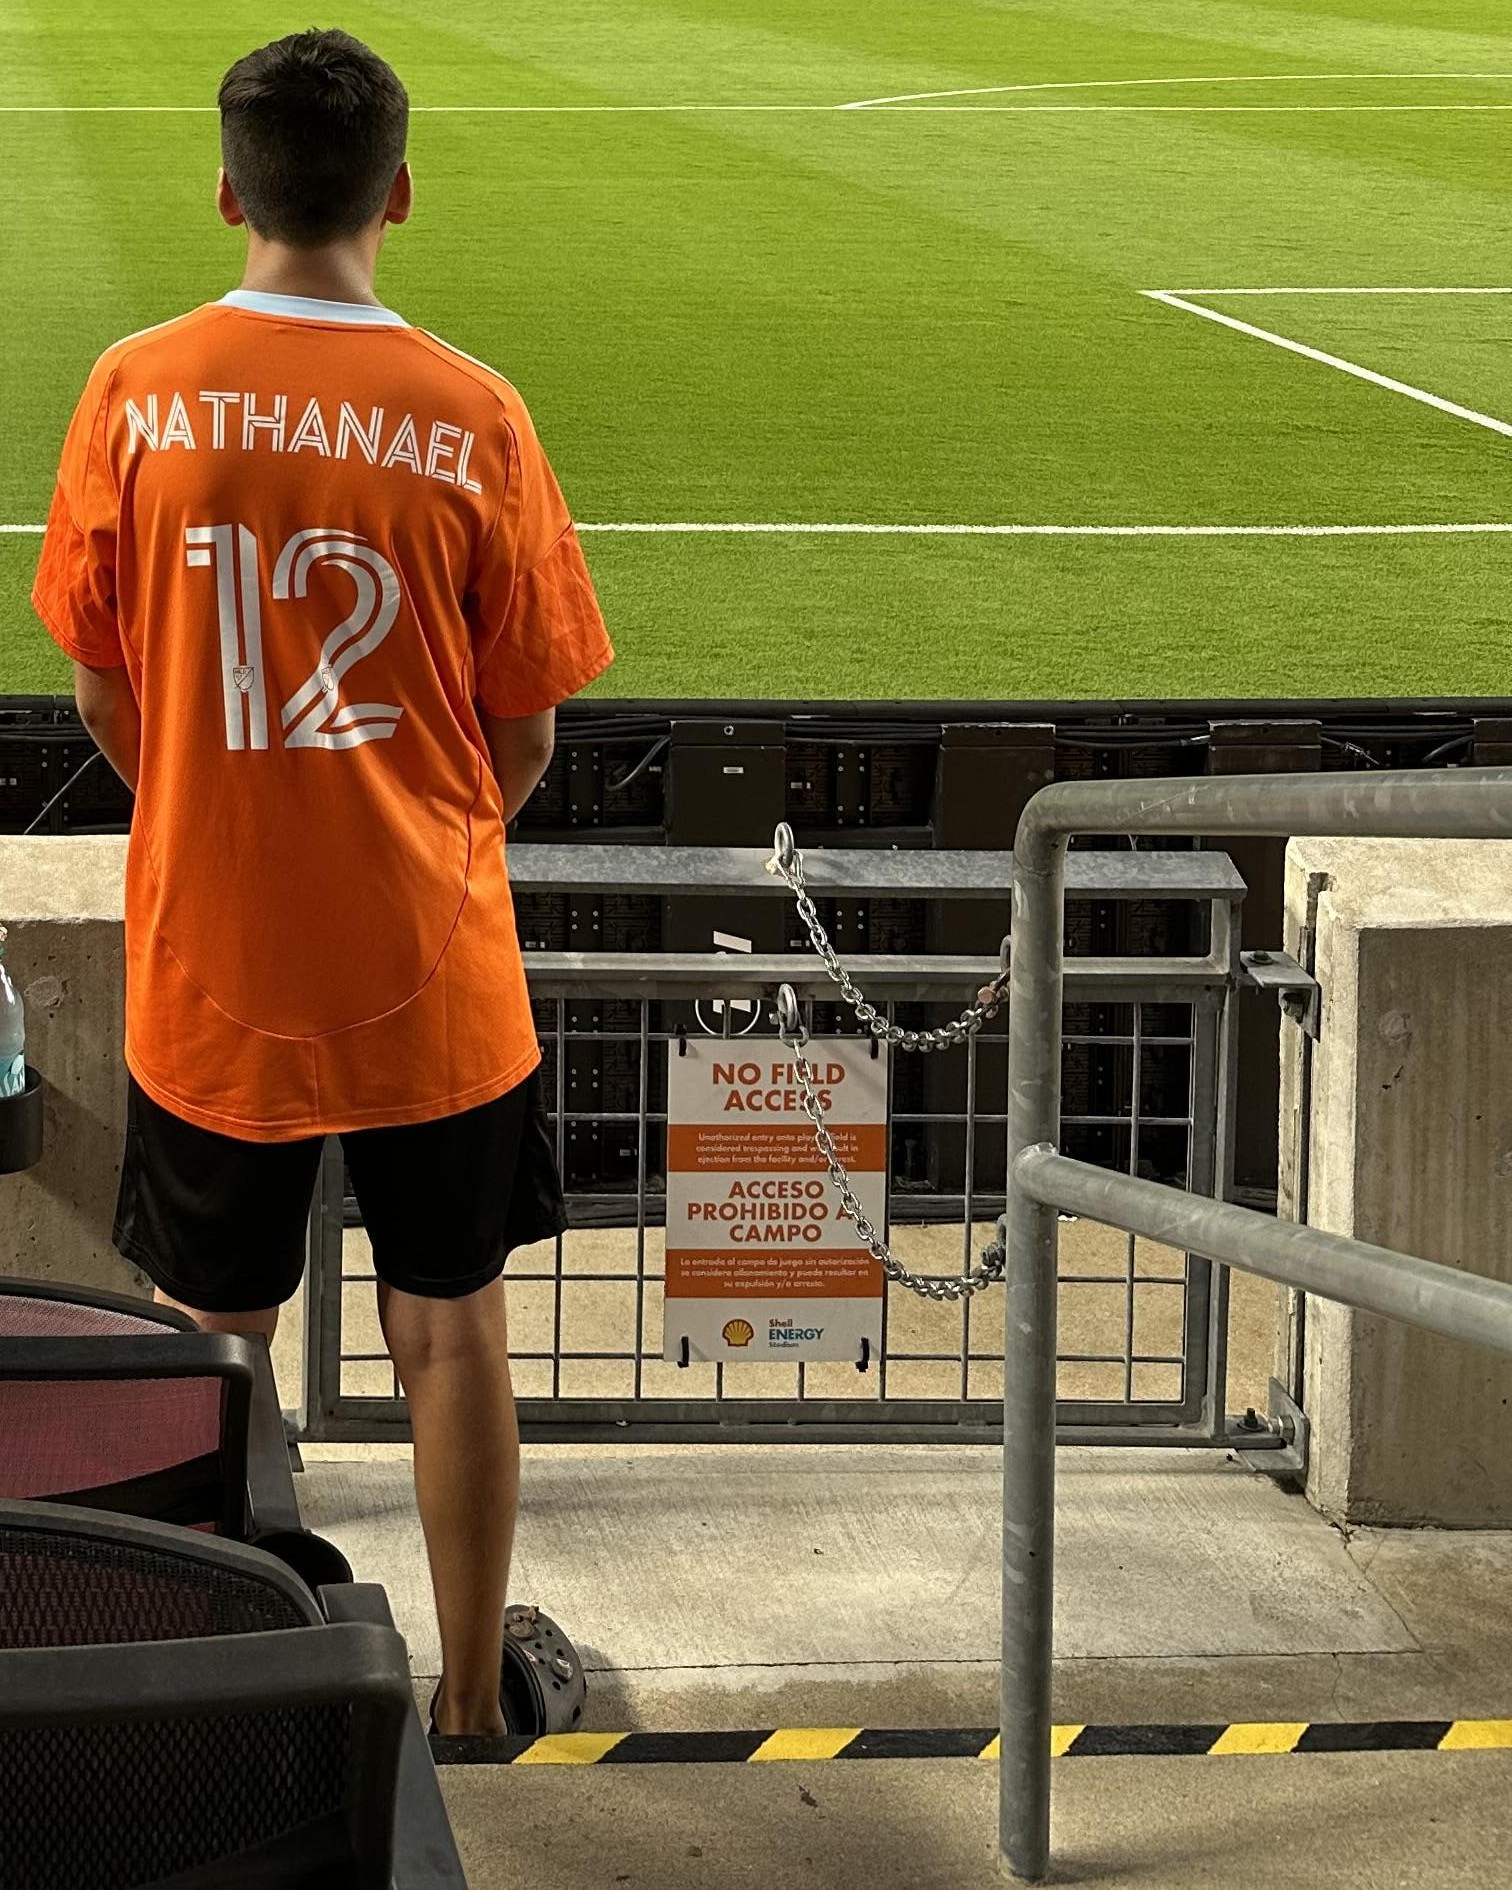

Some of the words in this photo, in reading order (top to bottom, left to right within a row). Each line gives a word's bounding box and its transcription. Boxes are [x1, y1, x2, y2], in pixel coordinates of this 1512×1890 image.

[125, 390, 483, 495] NATHANAEL
[185, 523, 404, 751] 12
[712, 1062, 762, 1086] NO
[696, 1144, 741, 1152] considered
[742, 1145, 790, 1154] trespassing
[791, 1144, 808, 1152] and
[697, 1155, 731, 1165] ejection
[753, 1155, 767, 1163] the
[768, 1155, 797, 1165] facility
[728, 1180, 824, 1199] ACCESO
[688, 1202, 829, 1221] PROHIBIDO
[729, 1224, 822, 1242] CAMPO
[692, 1257, 726, 1265] entrada
[779, 1258, 803, 1267] juego
[691, 1268, 731, 1277] considera
[797, 1268, 823, 1278] puede
[769, 1318, 793, 1328] Shell
[769, 1328, 824, 1340] ENERGY
